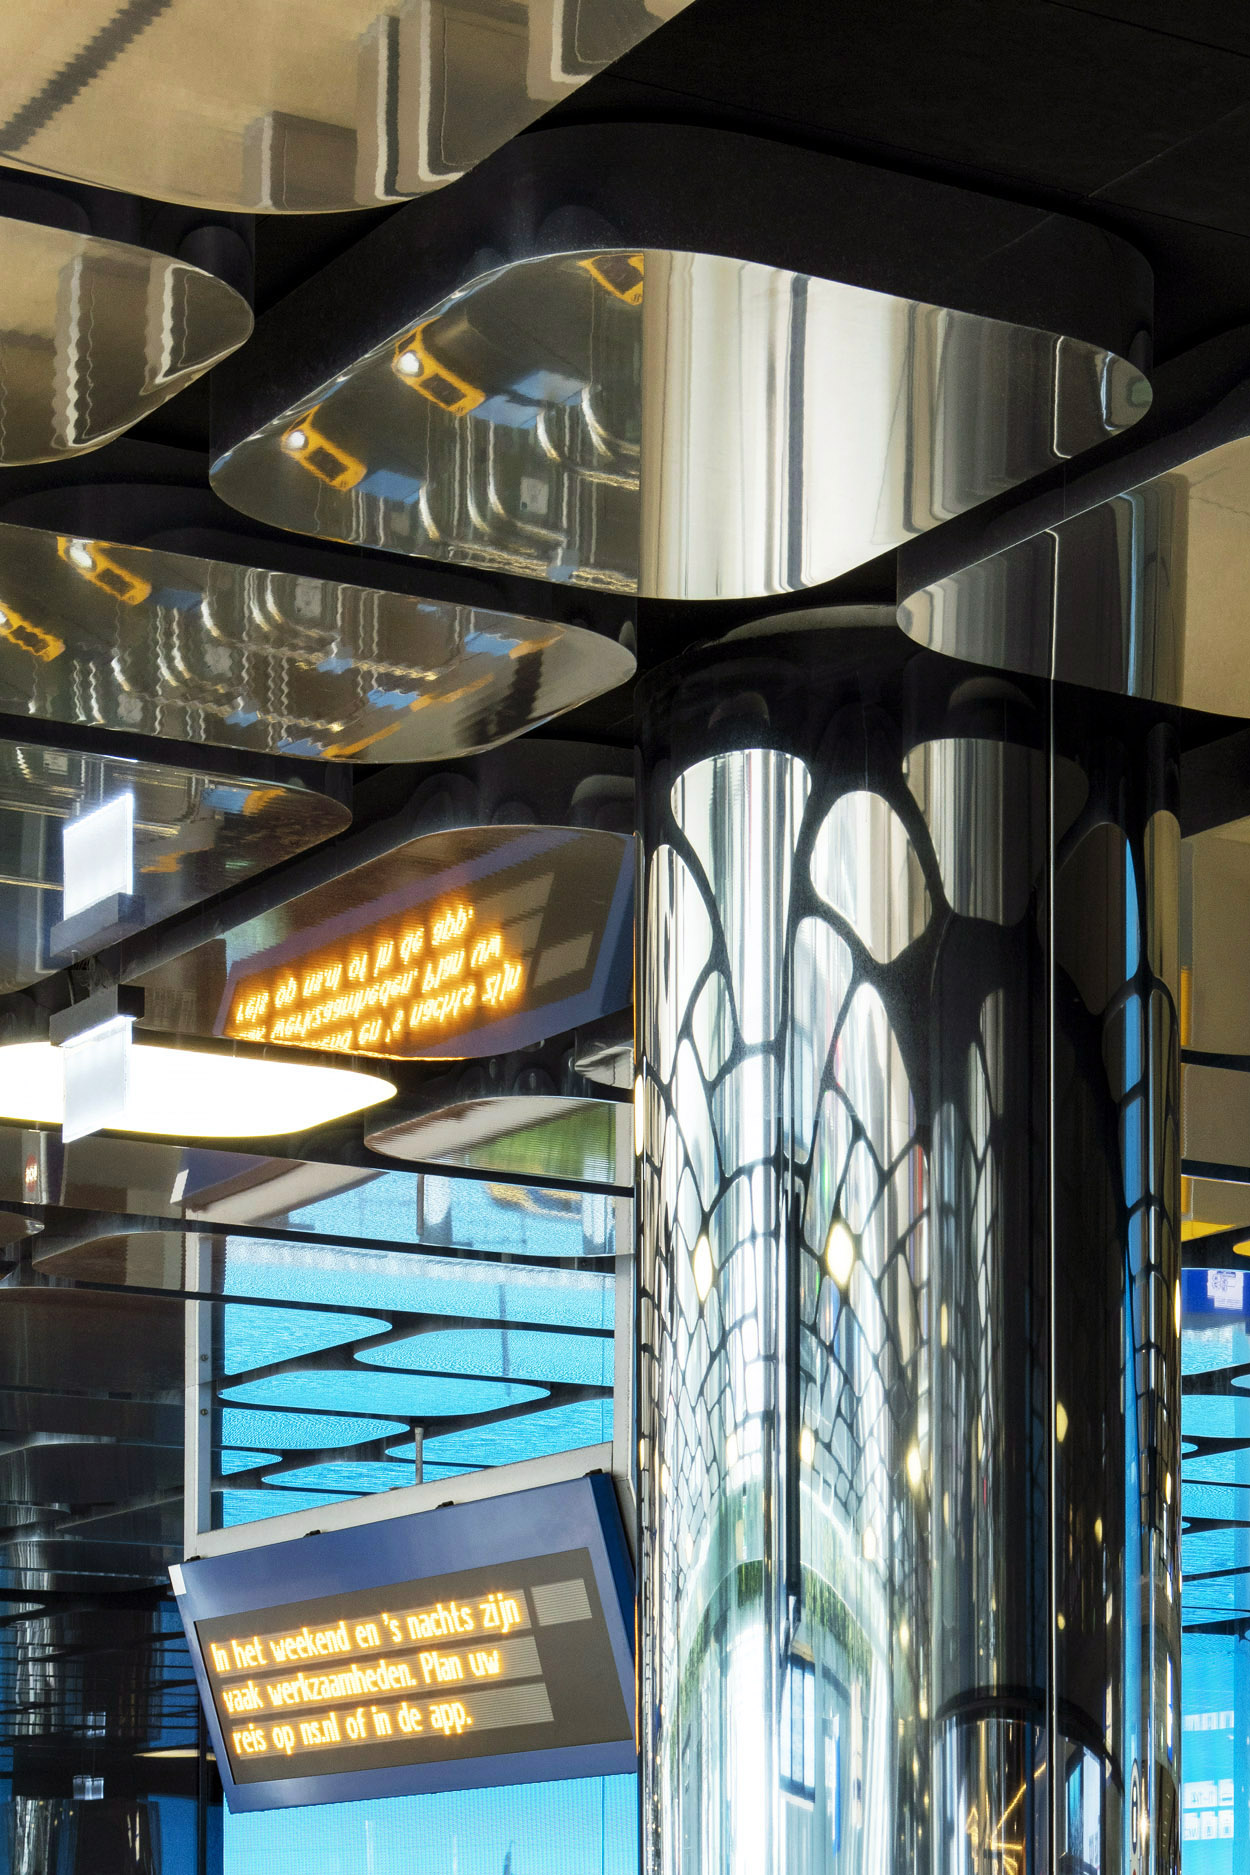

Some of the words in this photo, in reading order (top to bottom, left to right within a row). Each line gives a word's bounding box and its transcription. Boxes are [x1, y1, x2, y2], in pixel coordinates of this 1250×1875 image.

[211, 1643, 231, 1672] In
[231, 1639, 267, 1669] het
[269, 1620, 351, 1662] weekend
[355, 1623, 381, 1648] en
[382, 1612, 402, 1642] 's
[406, 1601, 475, 1640] nachts
[480, 1592, 521, 1634] zijn
[222, 1680, 264, 1713] vaak
[267, 1659, 418, 1706] werkzaamheden.
[419, 1651, 464, 1683] Plan
[467, 1650, 501, 1677] uw
[232, 1723, 267, 1754] reis
[272, 1724, 295, 1755] op
[300, 1711, 341, 1745] ns.nl
[346, 1707, 367, 1739] of
[371, 1705, 393, 1735] in
[398, 1701, 423, 1733] de
[429, 1702, 474, 1736] app.
